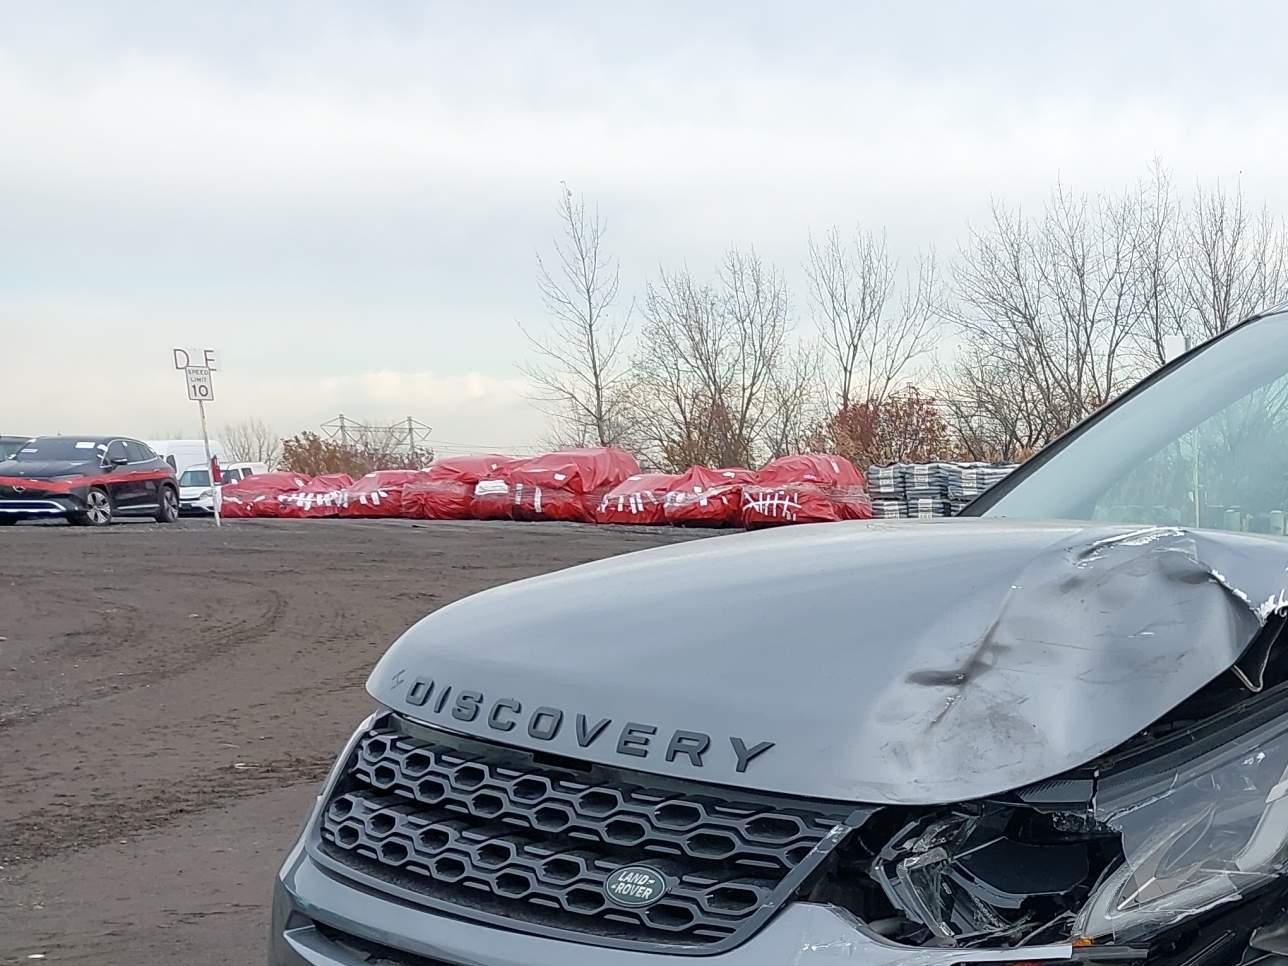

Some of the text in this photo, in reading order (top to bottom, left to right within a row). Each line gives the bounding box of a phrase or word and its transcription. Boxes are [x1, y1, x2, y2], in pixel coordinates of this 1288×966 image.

[173, 349, 190, 370] D
[188, 368, 209, 376] SPEED
[192, 384, 209, 397] 10
[405, 676, 775, 773] DISCOVERY
[618, 871, 650, 885] LAND
[614, 882, 653, 900] ROVER
